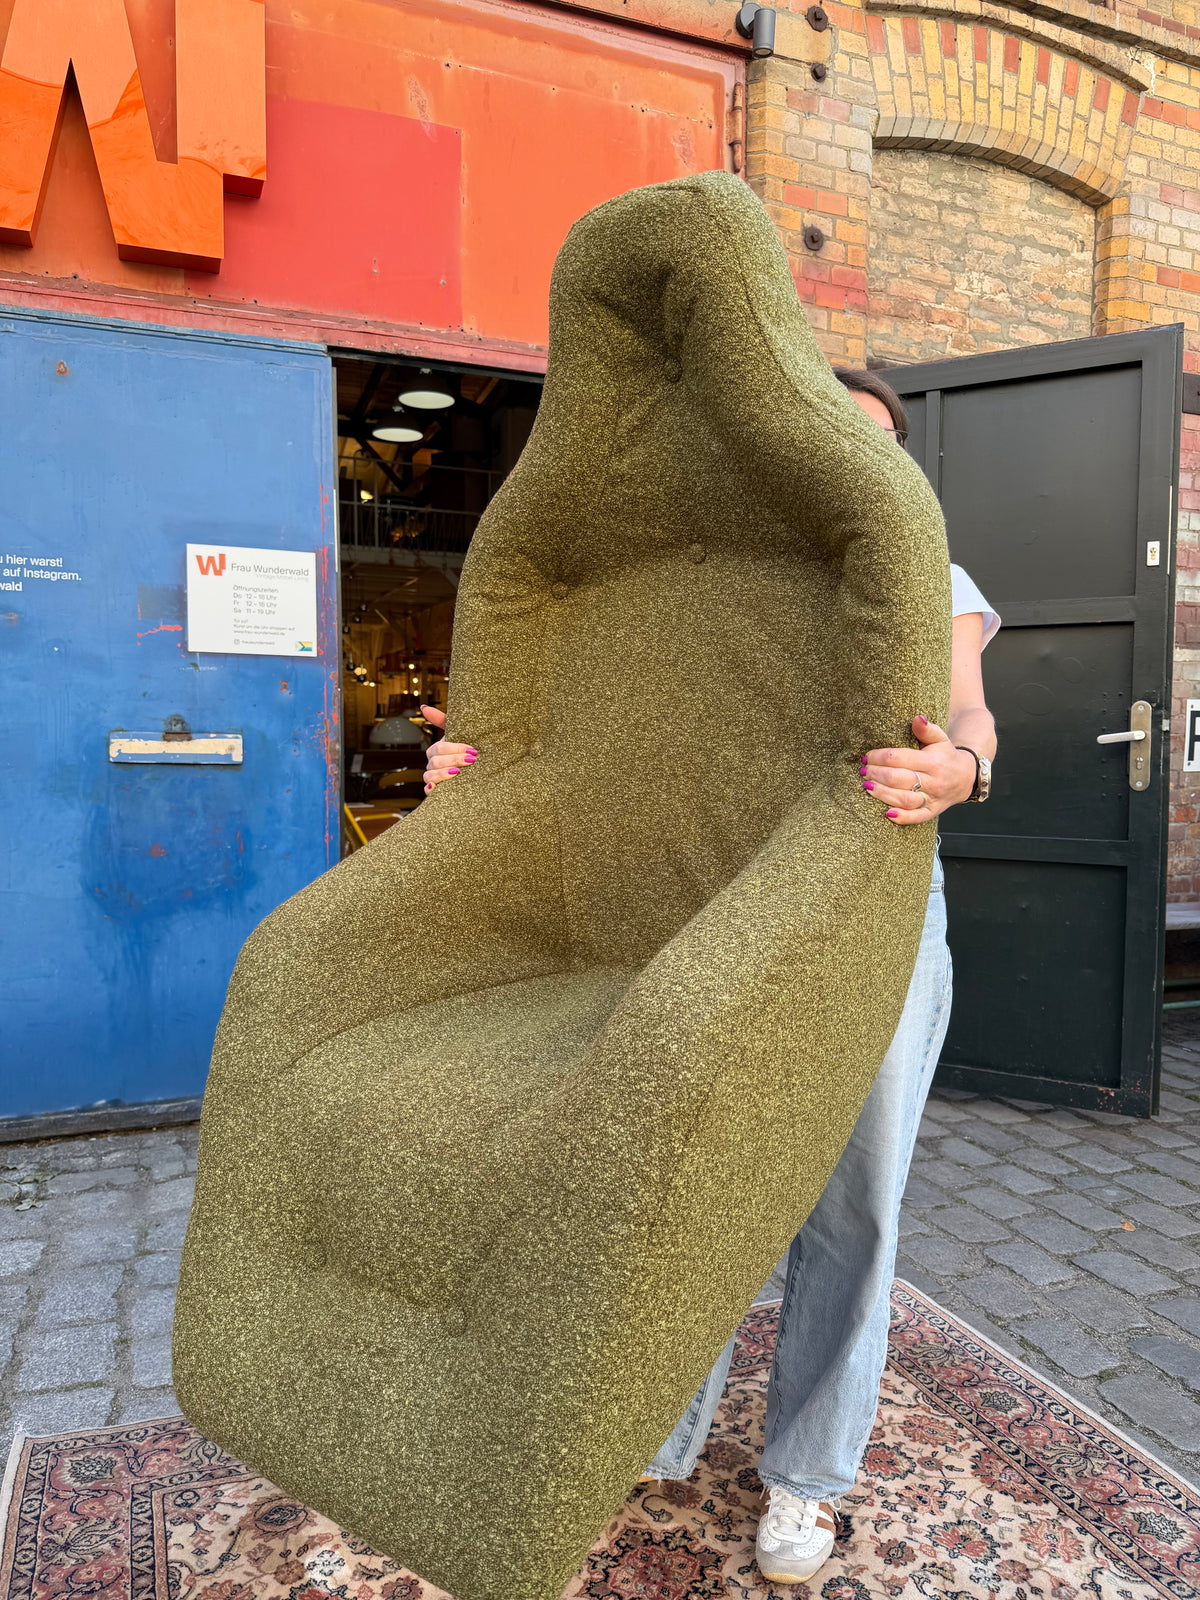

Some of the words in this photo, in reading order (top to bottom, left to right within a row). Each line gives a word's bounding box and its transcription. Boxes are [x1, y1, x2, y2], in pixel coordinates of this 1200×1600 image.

[6, 554, 28, 565] hier
[30, 557, 63, 567] warst!
[3, 567, 21, 577] auf
[23, 567, 82, 581] Instagram.
[231, 562, 252, 573] Frau
[253, 564, 309, 577] Wunderwald
